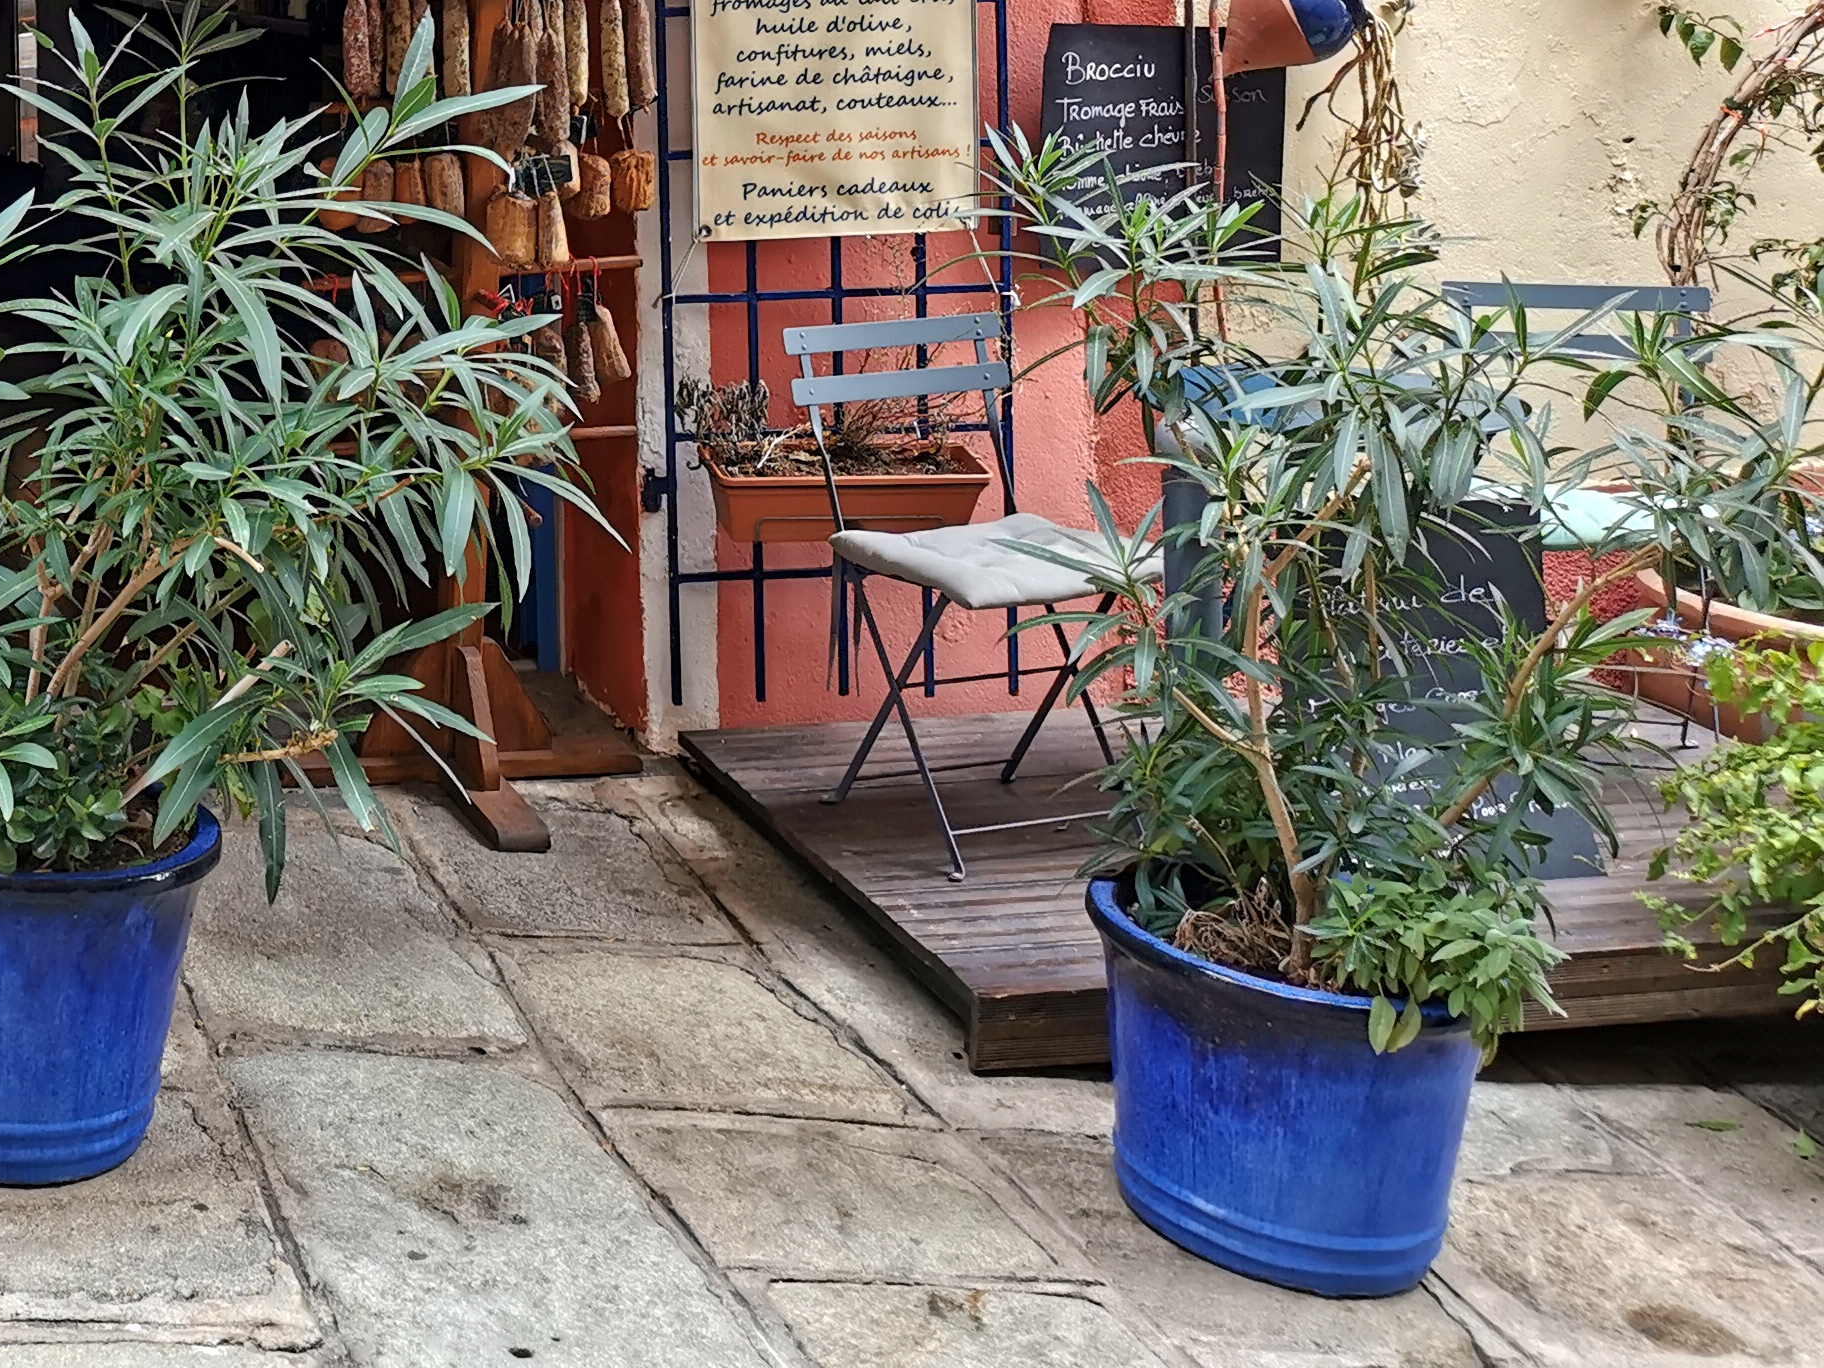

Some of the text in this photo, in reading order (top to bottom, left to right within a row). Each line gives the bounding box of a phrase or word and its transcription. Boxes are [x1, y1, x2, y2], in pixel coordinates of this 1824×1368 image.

[756, 16, 913, 35] huile d'olive,
[736, 39, 932, 66] confitures, miels,
[715, 65, 955, 94] farine de châtaigne,
[712, 99, 827, 117] artisanat,
[755, 128, 917, 147] Respect des saisons
[701, 155, 718, 167] et
[724, 149, 826, 167] savoir-faire
[832, 148, 854, 161] de
[858, 150, 886, 160] nos
[891, 146, 961, 159] artisans
[742, 177, 934, 200] Paniers cadeaux
[714, 201, 960, 229] et expédition de coli
